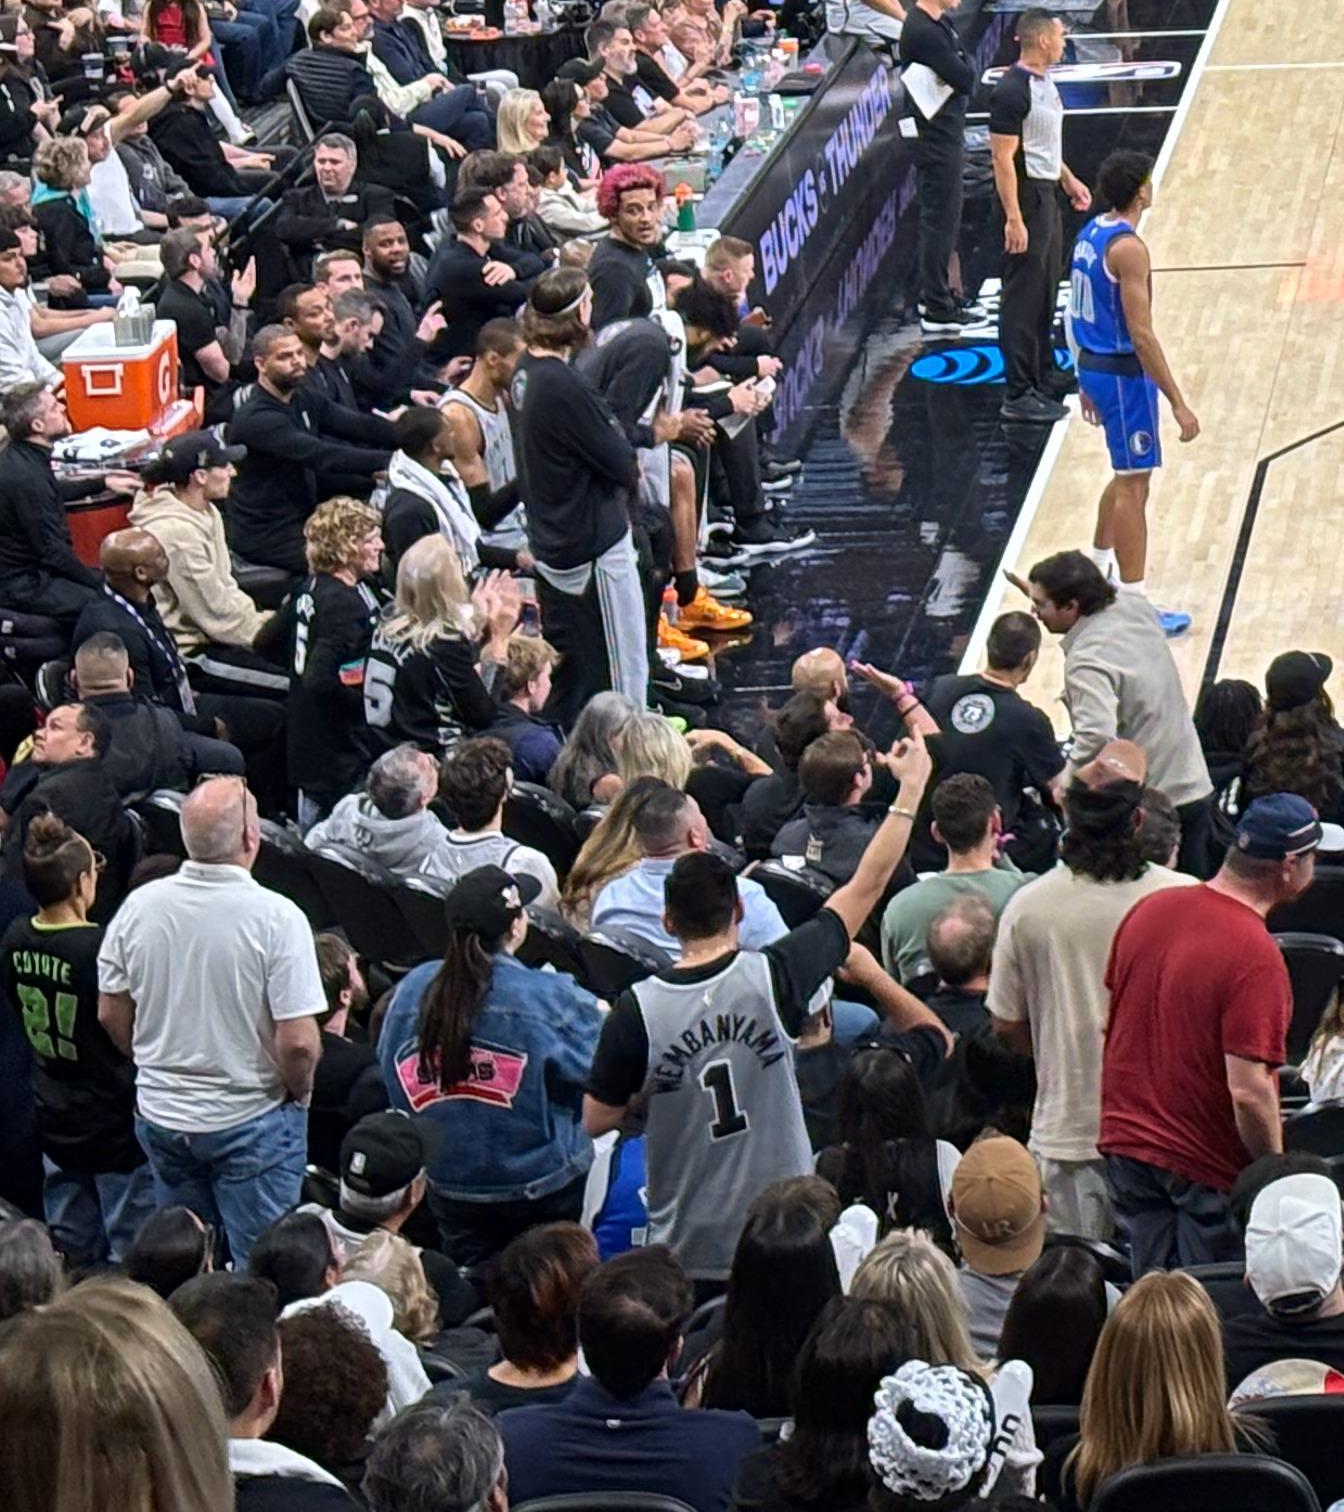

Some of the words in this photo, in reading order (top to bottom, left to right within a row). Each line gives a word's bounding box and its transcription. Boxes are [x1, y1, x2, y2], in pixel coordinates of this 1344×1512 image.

[759, 168, 819, 297] BUCKS
[824, 63, 893, 196] THUNDER
[363, 655, 398, 728] 5
[13, 949, 73, 986] COYOTE
[654, 1013, 786, 1095] WEMBANYAMA
[699, 1057, 749, 1144] 1
